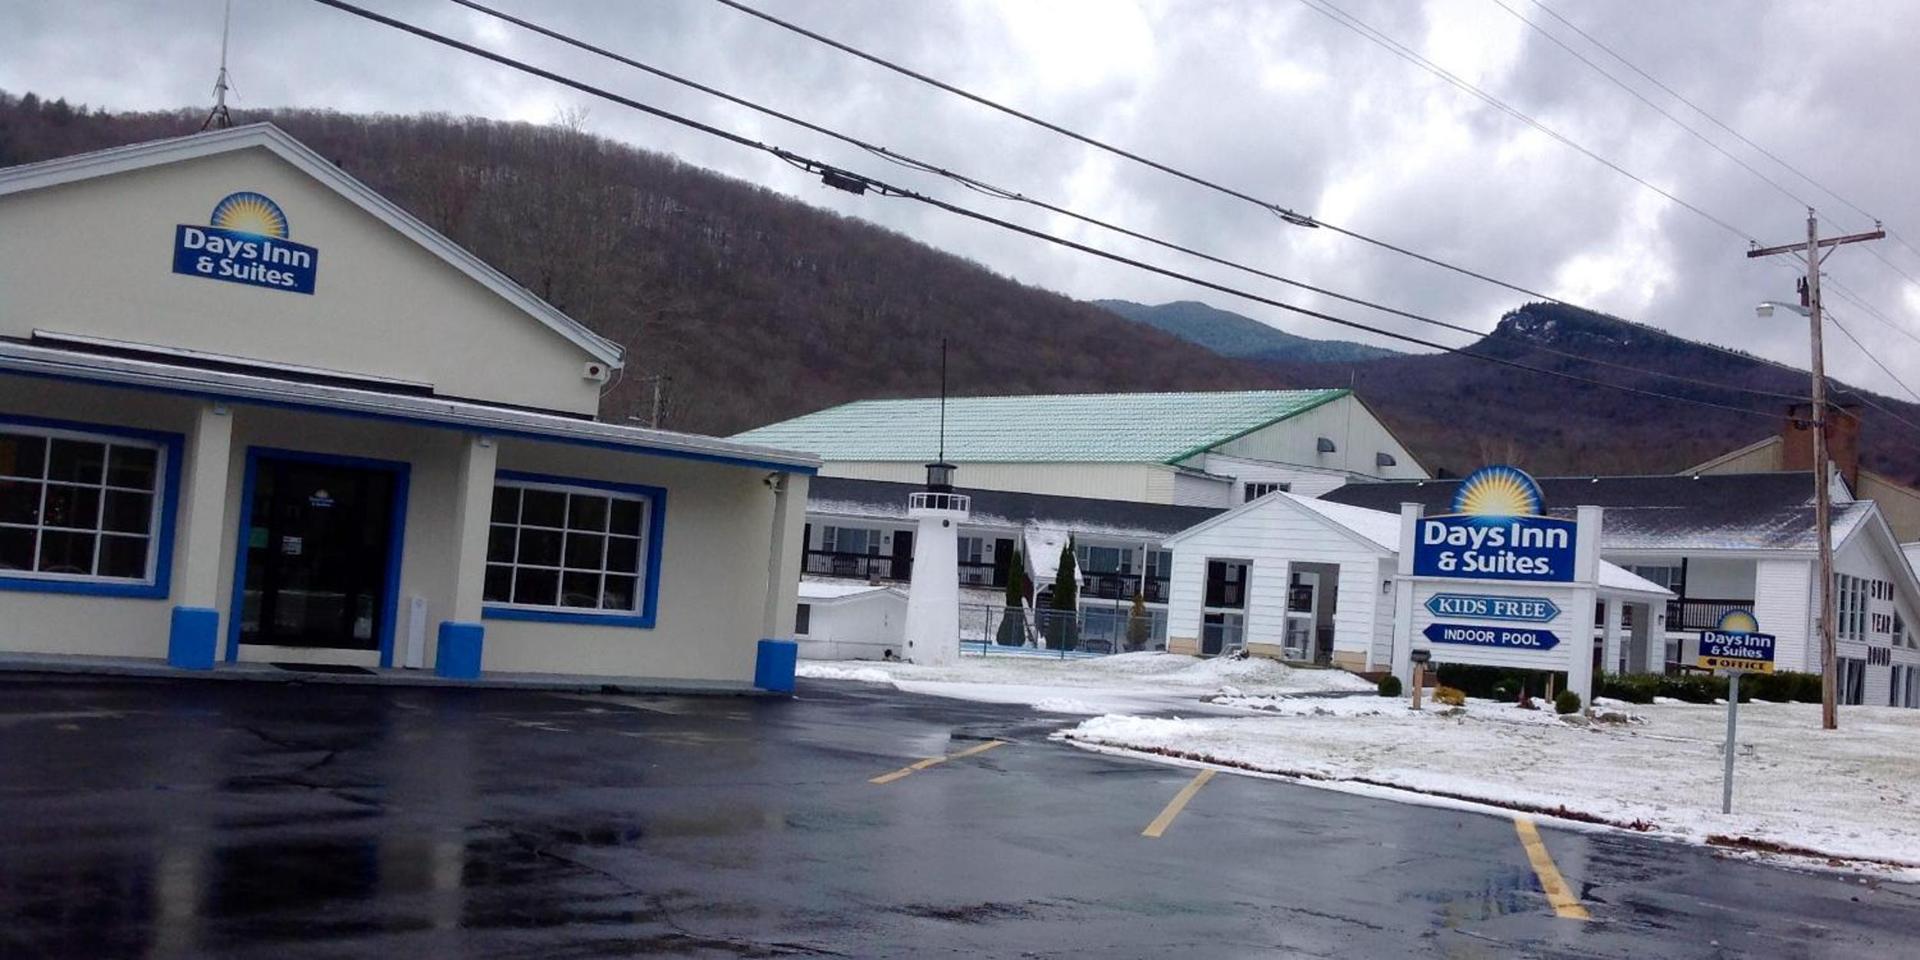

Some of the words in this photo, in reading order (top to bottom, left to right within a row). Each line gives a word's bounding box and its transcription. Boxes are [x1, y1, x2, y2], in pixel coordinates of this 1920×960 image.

[184, 228, 258, 258] Days
[262, 242, 310, 268] Inn
[196, 256, 214, 273] &
[1424, 521, 1505, 549] Days
[1511, 523, 1568, 548] Inn
[1438, 551, 1457, 571] &
[1438, 599, 1487, 614] KIDS
[1494, 600, 1546, 617] FREE
[1872, 612, 1891, 634] YEAR
[1444, 629, 1495, 643] INDOOR
[1502, 632, 1540, 646] POOL
[1704, 631, 1743, 645] Days
[1744, 634, 1771, 647] Inn
[1711, 645, 1720, 655] &
[1722, 645, 1763, 658] Suites
[1720, 659, 1764, 670] OFFICE
